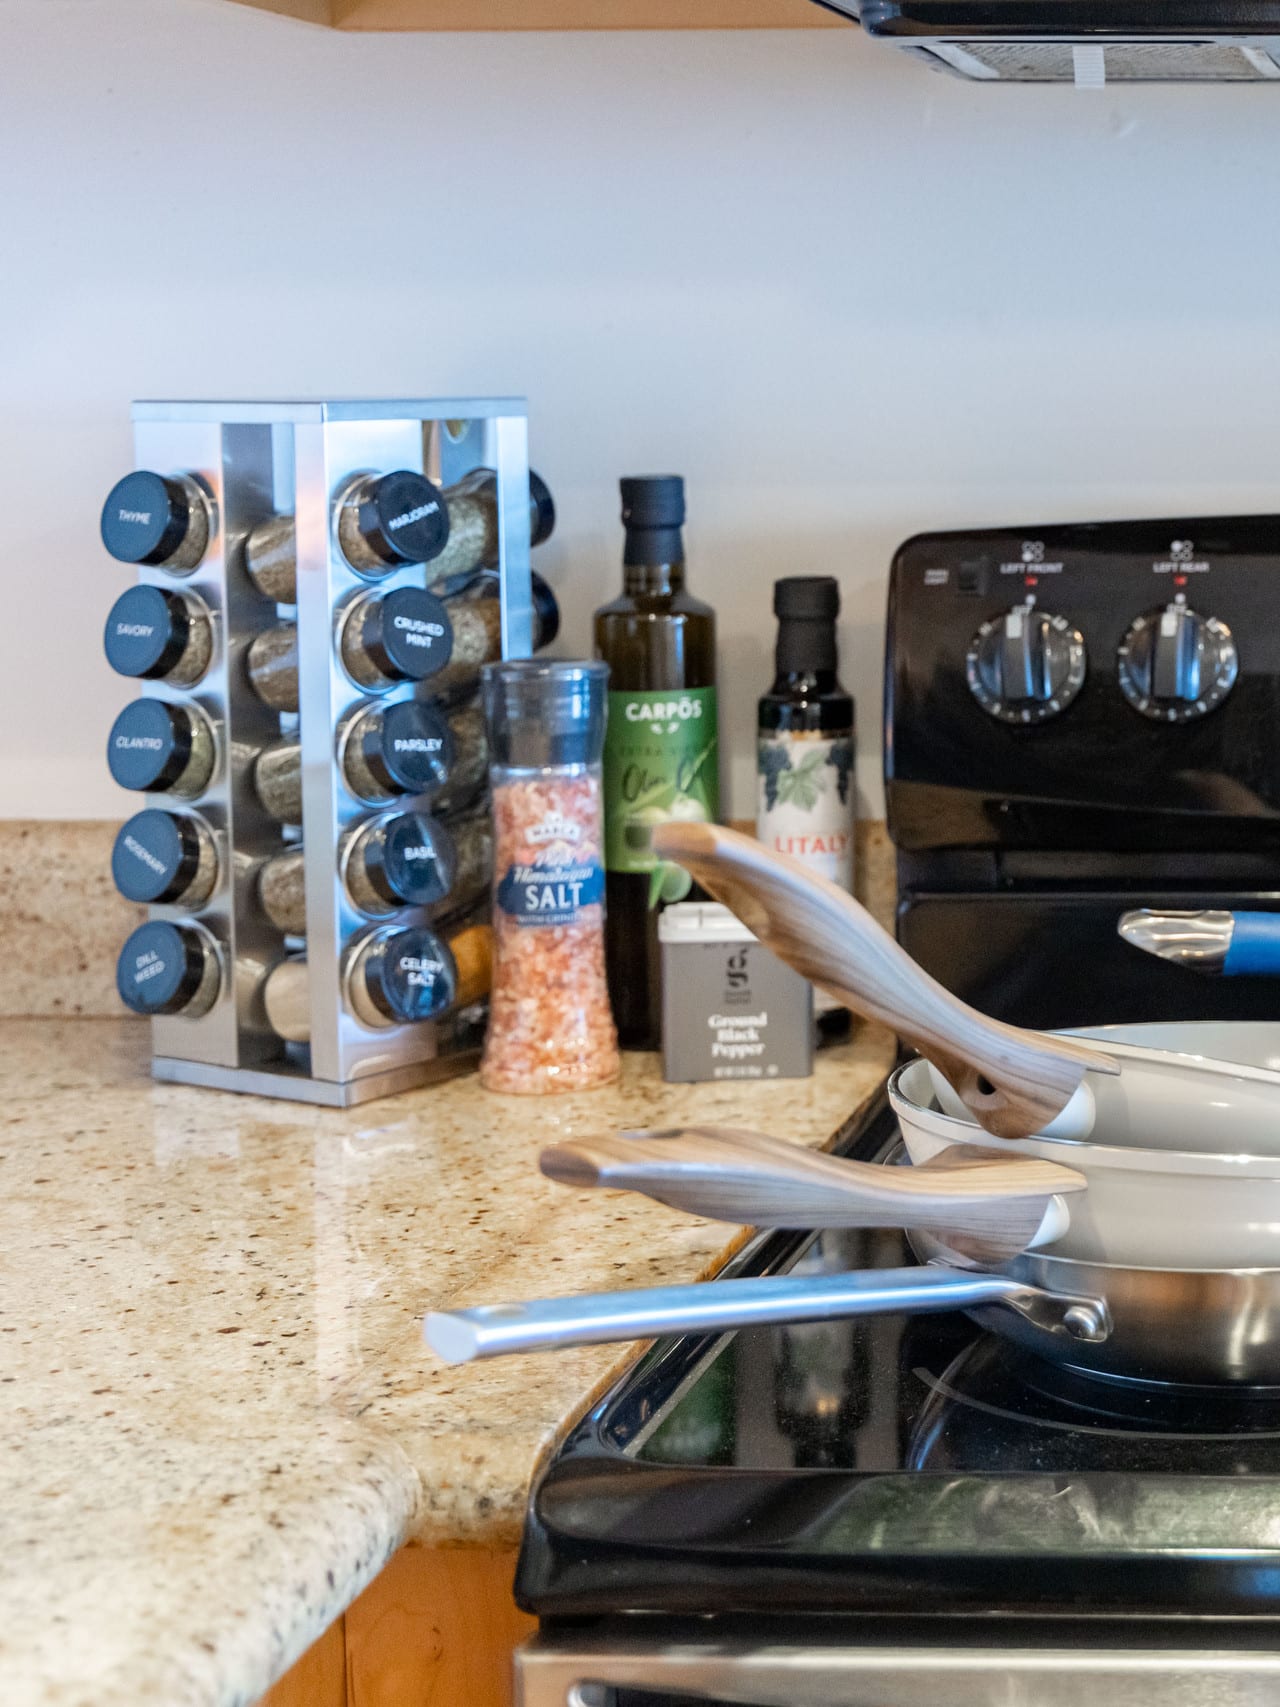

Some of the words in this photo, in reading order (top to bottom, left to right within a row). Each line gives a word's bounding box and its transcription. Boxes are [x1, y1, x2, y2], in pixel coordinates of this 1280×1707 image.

[119, 509, 152, 525] THYME
[388, 501, 440, 531] MARJORAM
[116, 622, 154, 637] SAVORY
[394, 615, 445, 637] CRUSHED
[405, 632, 433, 649] MINT
[115, 735, 163, 751] CILANTRO
[394, 738, 443, 752] PARSLEY
[404, 846, 437, 861] BASIL
[524, 882, 584, 911] SALT
[400, 956, 444, 974] CELERY
[407, 971, 435, 987] SALT
[707, 1011, 768, 1028] Ground
[717, 1027, 760, 1042] Black
[711, 1042, 766, 1059] Pepper
